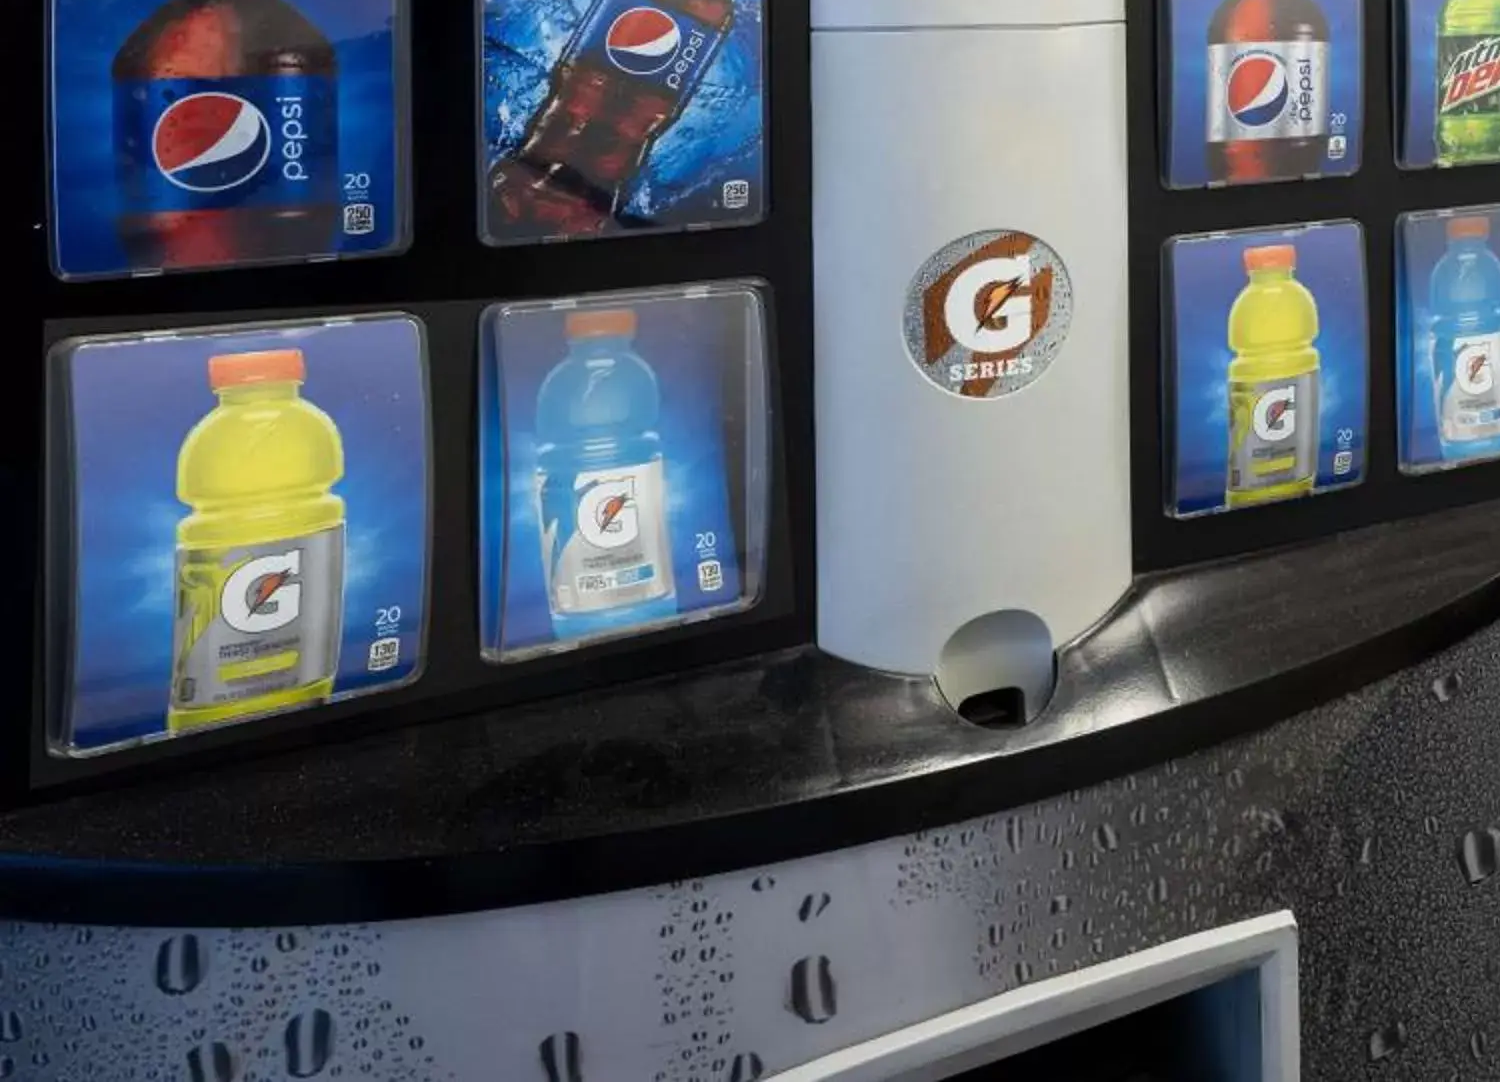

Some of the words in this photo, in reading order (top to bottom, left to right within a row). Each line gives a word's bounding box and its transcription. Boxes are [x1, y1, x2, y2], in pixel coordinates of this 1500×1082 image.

[667, 28, 706, 90] pepsi
[1297, 58, 1314, 121] pepsi
[276, 97, 309, 180] pepsi
[1330, 112, 1347, 125] 20
[343, 173, 371, 189] 20
[726, 184, 747, 195] 250
[944, 255, 1032, 353] G
[949, 357, 1034, 381] SERIES
[1253, 385, 1297, 441] G
[578, 477, 639, 549] G
[695, 532, 717, 548] 20
[221, 548, 303, 633] G
[376, 606, 401, 625] 20
